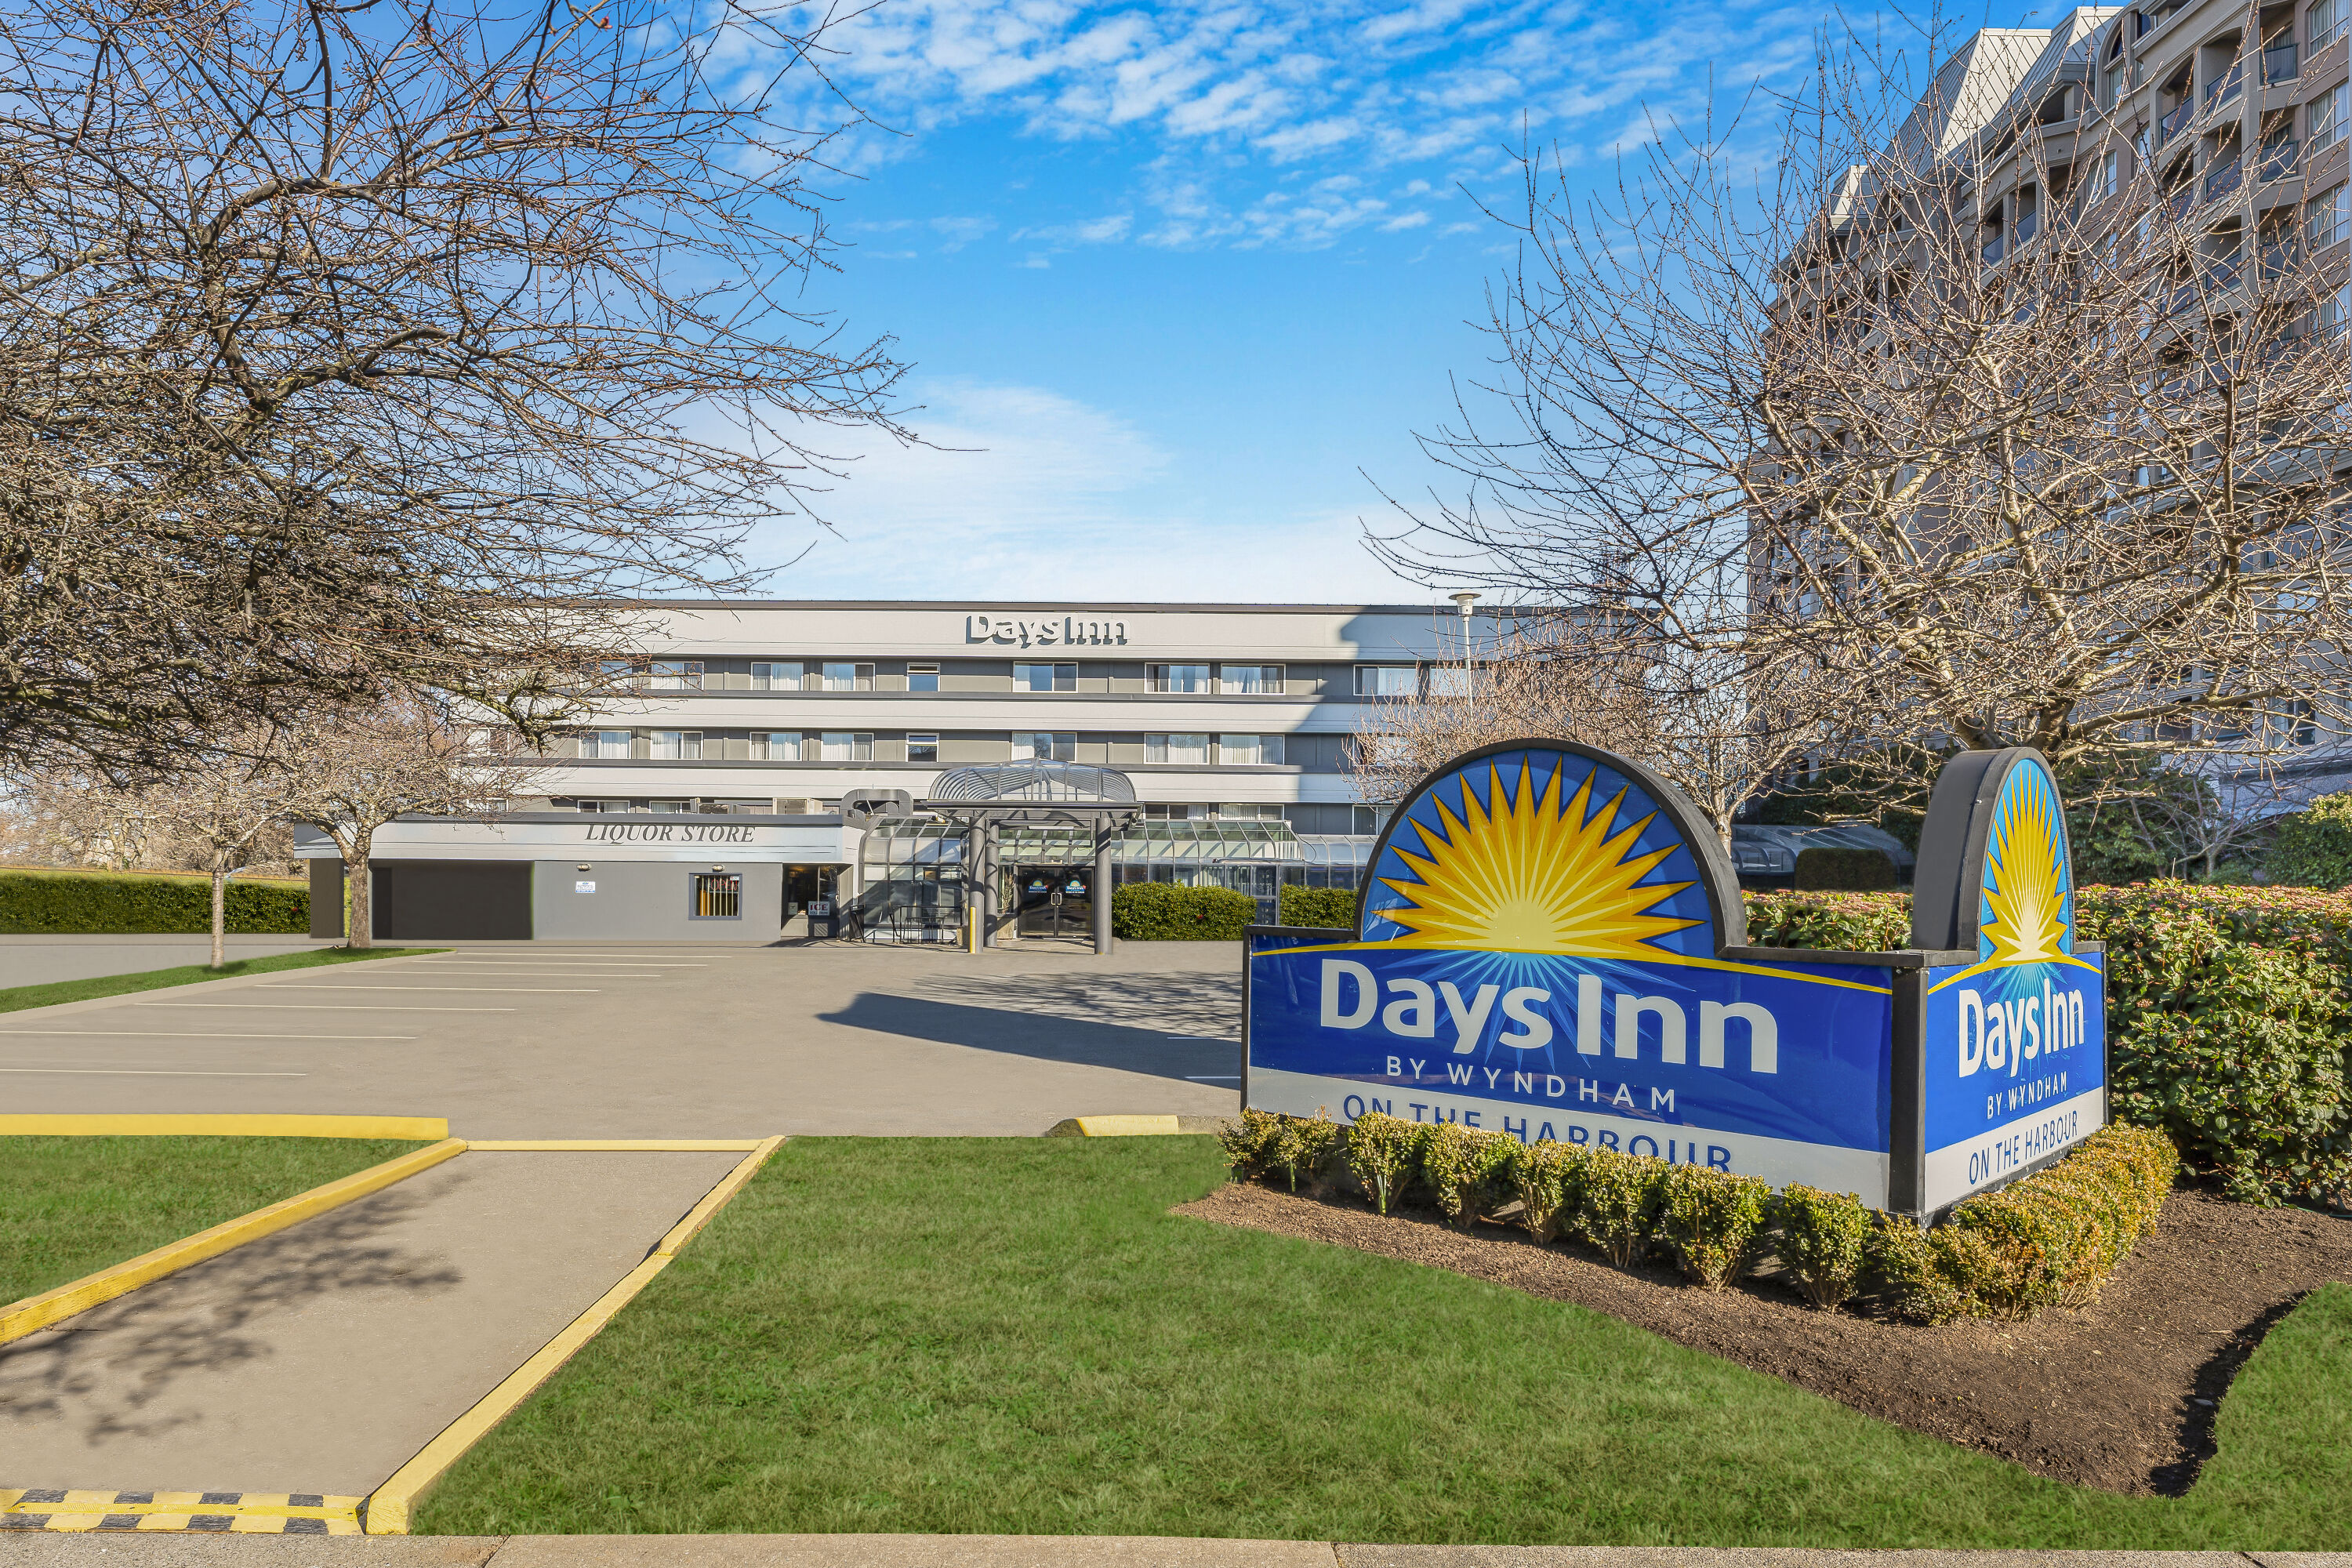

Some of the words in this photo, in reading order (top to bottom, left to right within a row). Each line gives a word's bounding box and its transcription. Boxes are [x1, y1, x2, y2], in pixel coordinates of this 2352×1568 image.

[968, 612, 1062, 647] Days
[1066, 612, 1131, 643] Inn
[584, 824, 673, 844] LIQUOR
[681, 826, 756, 843] STORE
[710, 879, 738, 891] OPEN
[1320, 958, 1553, 1054] Days
[1577, 974, 1778, 1074] Inn
[1958, 989, 2040, 1078] Days
[2043, 978, 2085, 1054] Inn
[1387, 1056, 1426, 1080] BY
[1446, 1062, 1675, 1112] WYNDHAM
[1987, 1091, 2002, 1120] BY
[2008, 1071, 2067, 1112] WYNDHAM
[1342, 1094, 1392, 1119] ON
[1410, 1102, 1481, 1127] THE
[1969, 1147, 1990, 1185] ON
[1995, 1135, 2020, 1173] THE
[2025, 1110, 2078, 1160] HARBOUR
